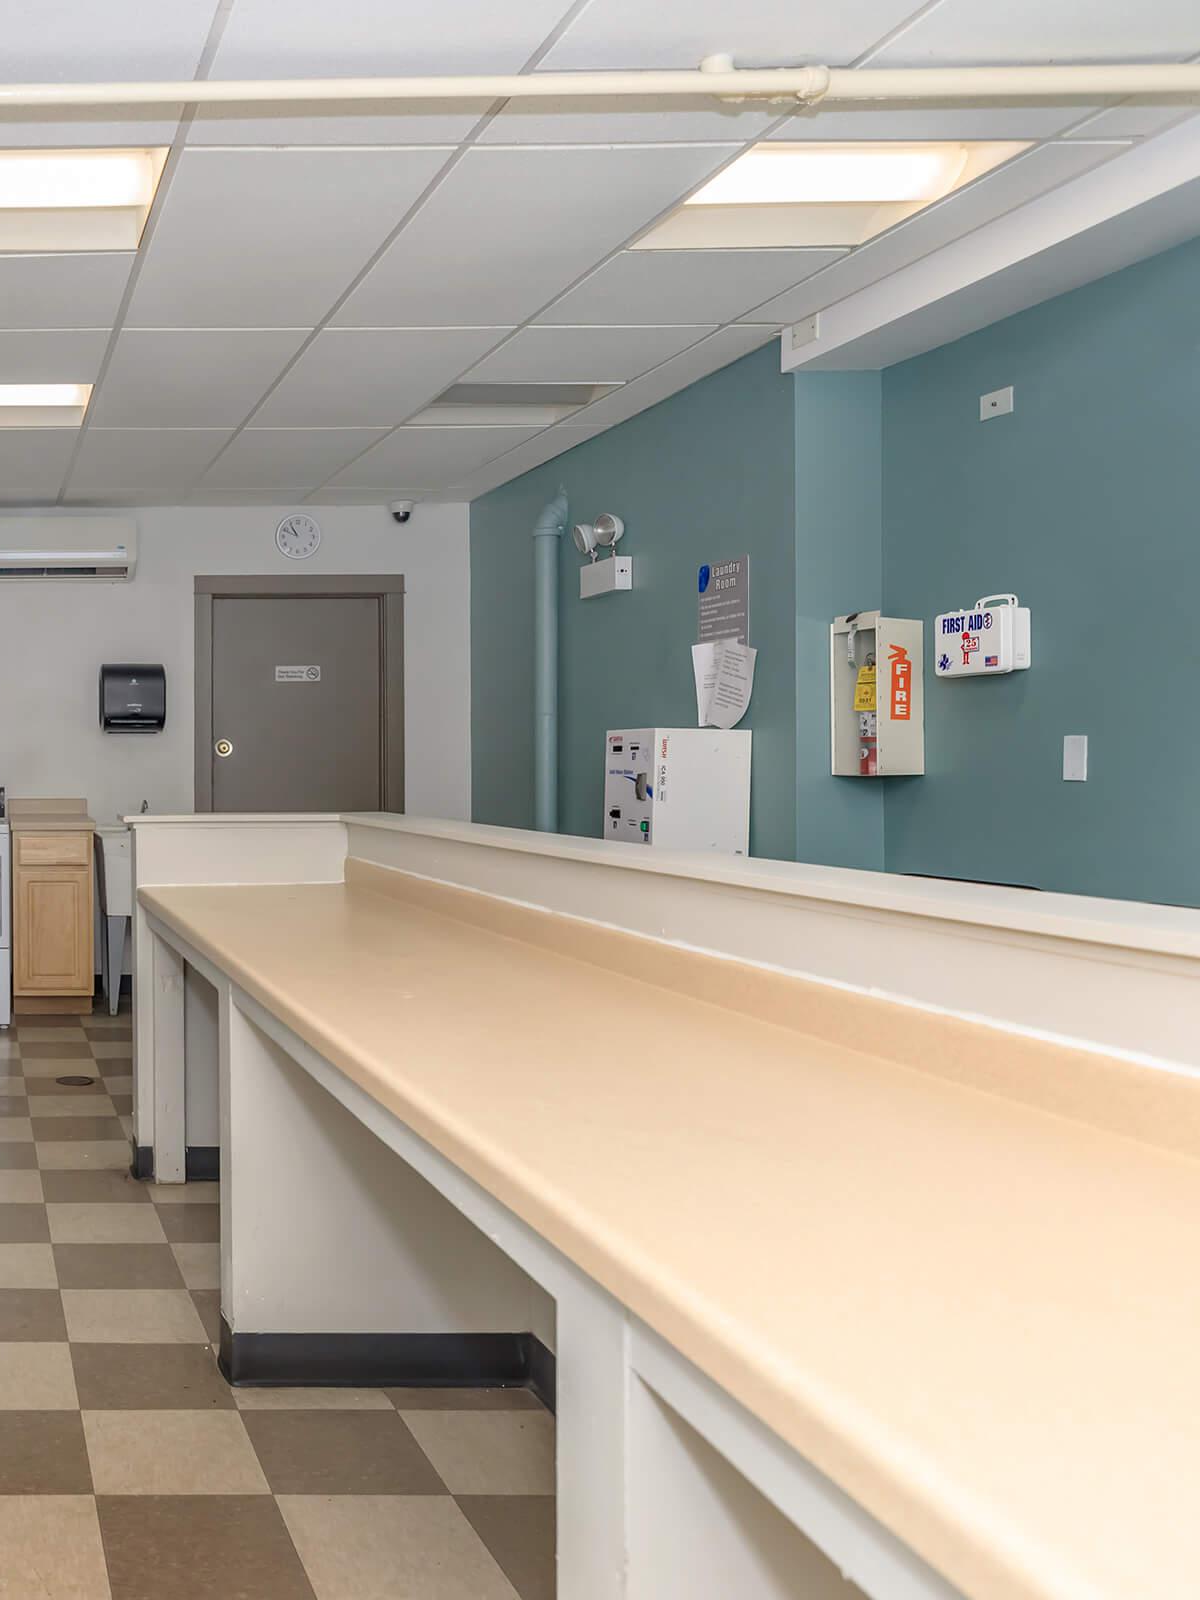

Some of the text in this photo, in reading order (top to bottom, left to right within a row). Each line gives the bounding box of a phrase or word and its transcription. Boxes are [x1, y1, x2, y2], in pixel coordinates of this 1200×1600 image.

[712, 562, 740, 578] Laundry
[715, 577, 736, 591] Room
[942, 614, 983, 634] FIRST AID
[966, 639, 977, 648] 25
[895, 663, 908, 715] FIRE
